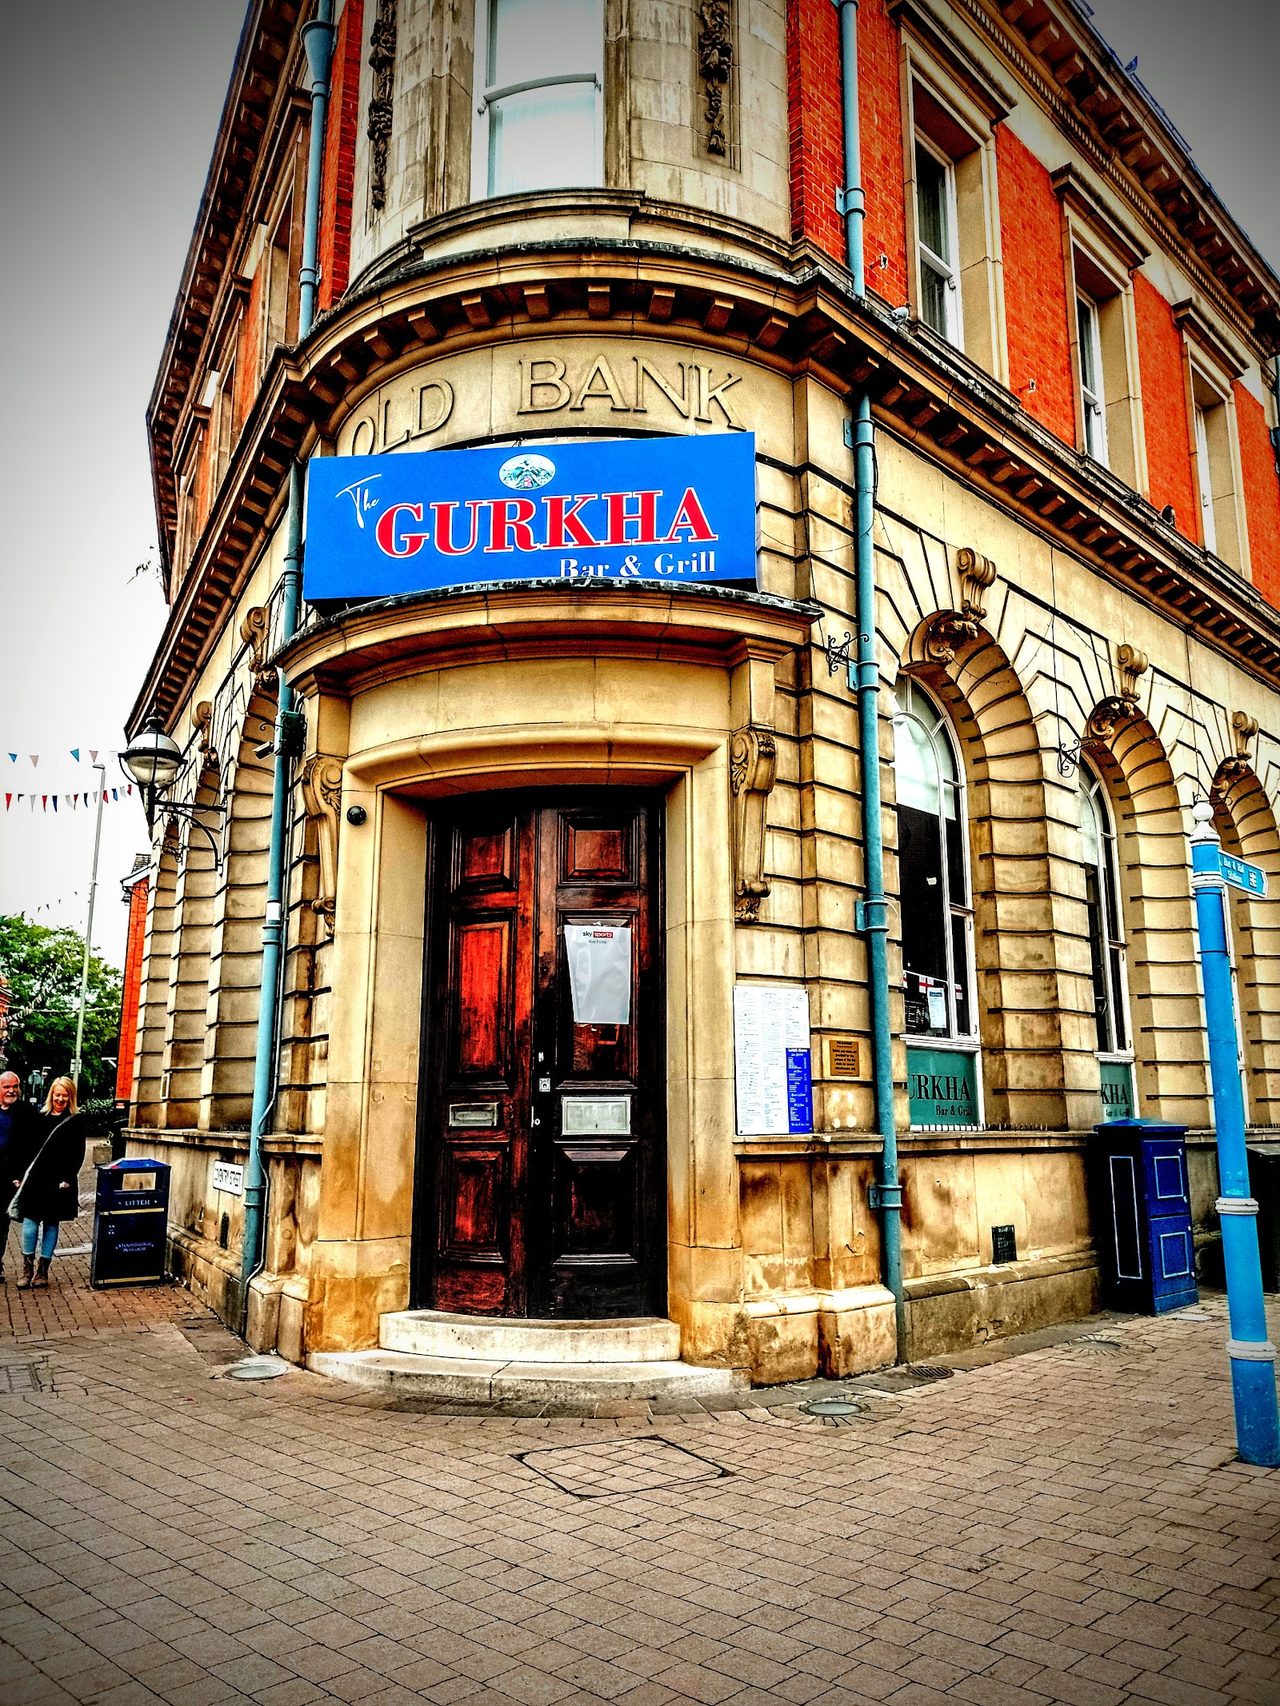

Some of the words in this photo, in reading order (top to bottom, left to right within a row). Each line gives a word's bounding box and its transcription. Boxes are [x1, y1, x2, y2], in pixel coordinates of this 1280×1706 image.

[350, 378, 455, 455] OLD
[516, 354, 747, 431] BANK
[335, 473, 382, 529] The
[375, 486, 719, 559] GURKHA
[560, 558, 610, 577] Bar
[619, 554, 642, 577] &
[654, 550, 716, 575] Grill
[936, 1104, 948, 1116] Bar
[950, 1104, 956, 1116] &
